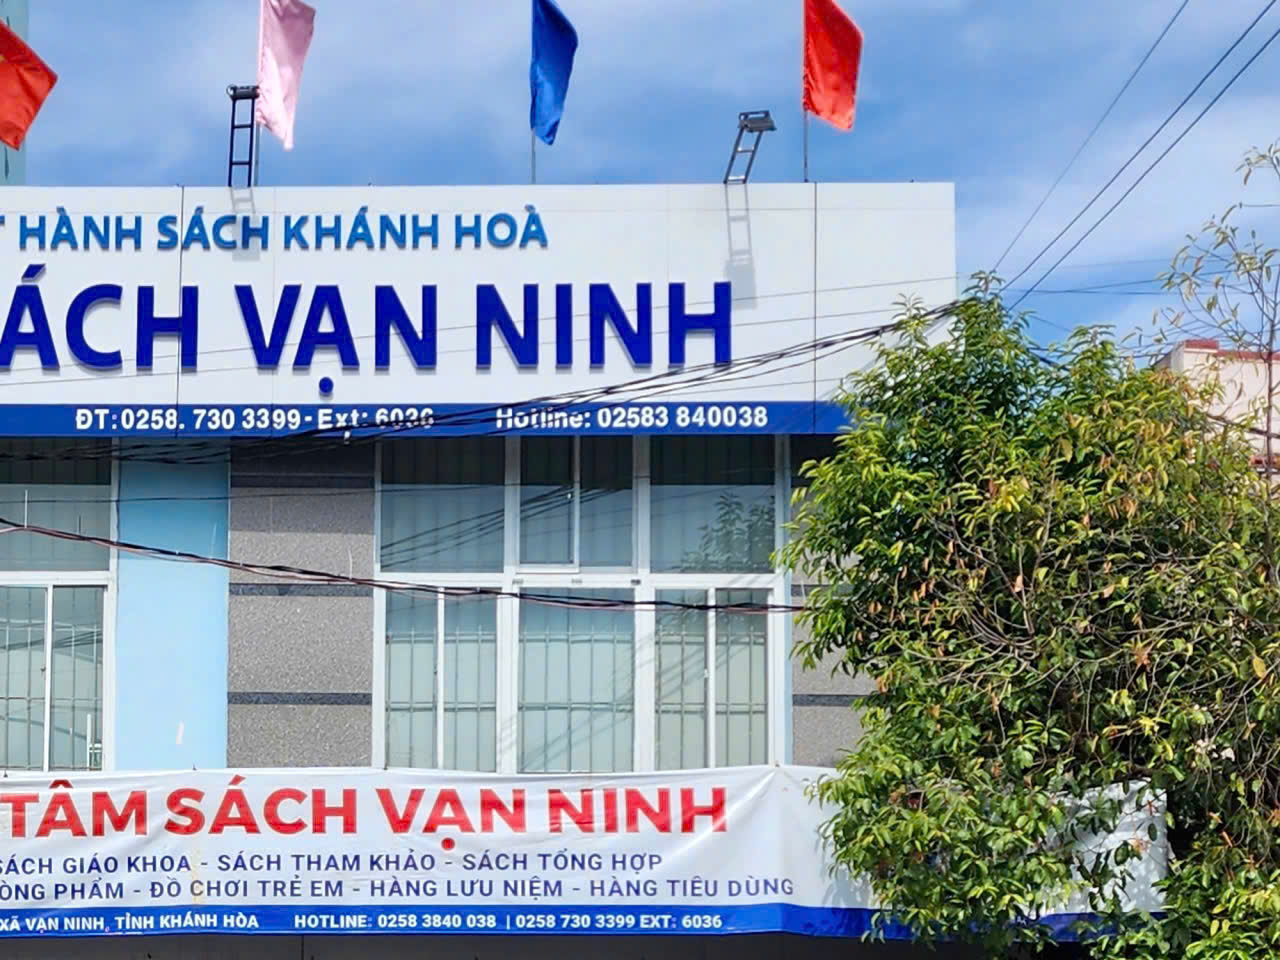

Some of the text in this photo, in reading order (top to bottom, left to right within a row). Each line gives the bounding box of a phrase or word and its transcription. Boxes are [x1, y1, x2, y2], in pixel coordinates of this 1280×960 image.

[20, 207, 142, 251] HÀNH
[157, 205, 270, 251] SÁCH
[284, 205, 440, 251] KHÁNH
[455, 204, 549, 251] HOÀ
[236, 280, 437, 397] VẠN
[476, 281, 733, 372] NINH
[194, 408, 235, 430] 730
[597, 406, 669, 428] 02583
[676, 406, 768, 428] 840038
[0, 779, 149, 839] TÂM
[165, 775, 357, 836] SÁCH
[376, 787, 527, 851] VẠN
[547, 787, 728, 834] NINH
[63, 852, 118, 874] GIÁO
[127, 855, 191, 873] KHOA
[217, 850, 281, 872] SÁCH
[291, 853, 361, 872] THAM
[370, 848, 436, 872] KHẢO
[462, 849, 528, 871] SÁCH
[612, 852, 662, 875] HỢP
[54, 877, 124, 900] PHẨM
[149, 875, 181, 898] ĐỒ
[190, 879, 248, 898] CHƠI
[257, 873, 302, 897] TRẺ
[310, 880, 343, 897] EM
[370, 876, 437, 897] HÀNG
[447, 879, 493, 897] LƯU
[503, 876, 562, 901] NIỆM
[590, 875, 657, 897] HÀNG
[666, 875, 718, 897] TIÊU
[728, 874, 793, 896] DÙNG
[26, 916, 59, 934] VẠN
[115, 912, 154, 930] TỈNH
[160, 911, 217, 929] KHÁNH
[223, 911, 259, 929] HÒA
[294, 914, 373, 929] HOTLINE:
[378, 914, 418, 929] 0258
[422, 914, 462, 929] 3840
[467, 914, 497, 929] 038
[516, 914, 556, 929] 0258
[560, 914, 591, 929] 730
[595, 914, 636, 929] 3399
[640, 914, 677, 929] EXT:
[682, 914, 722, 928] 6036
